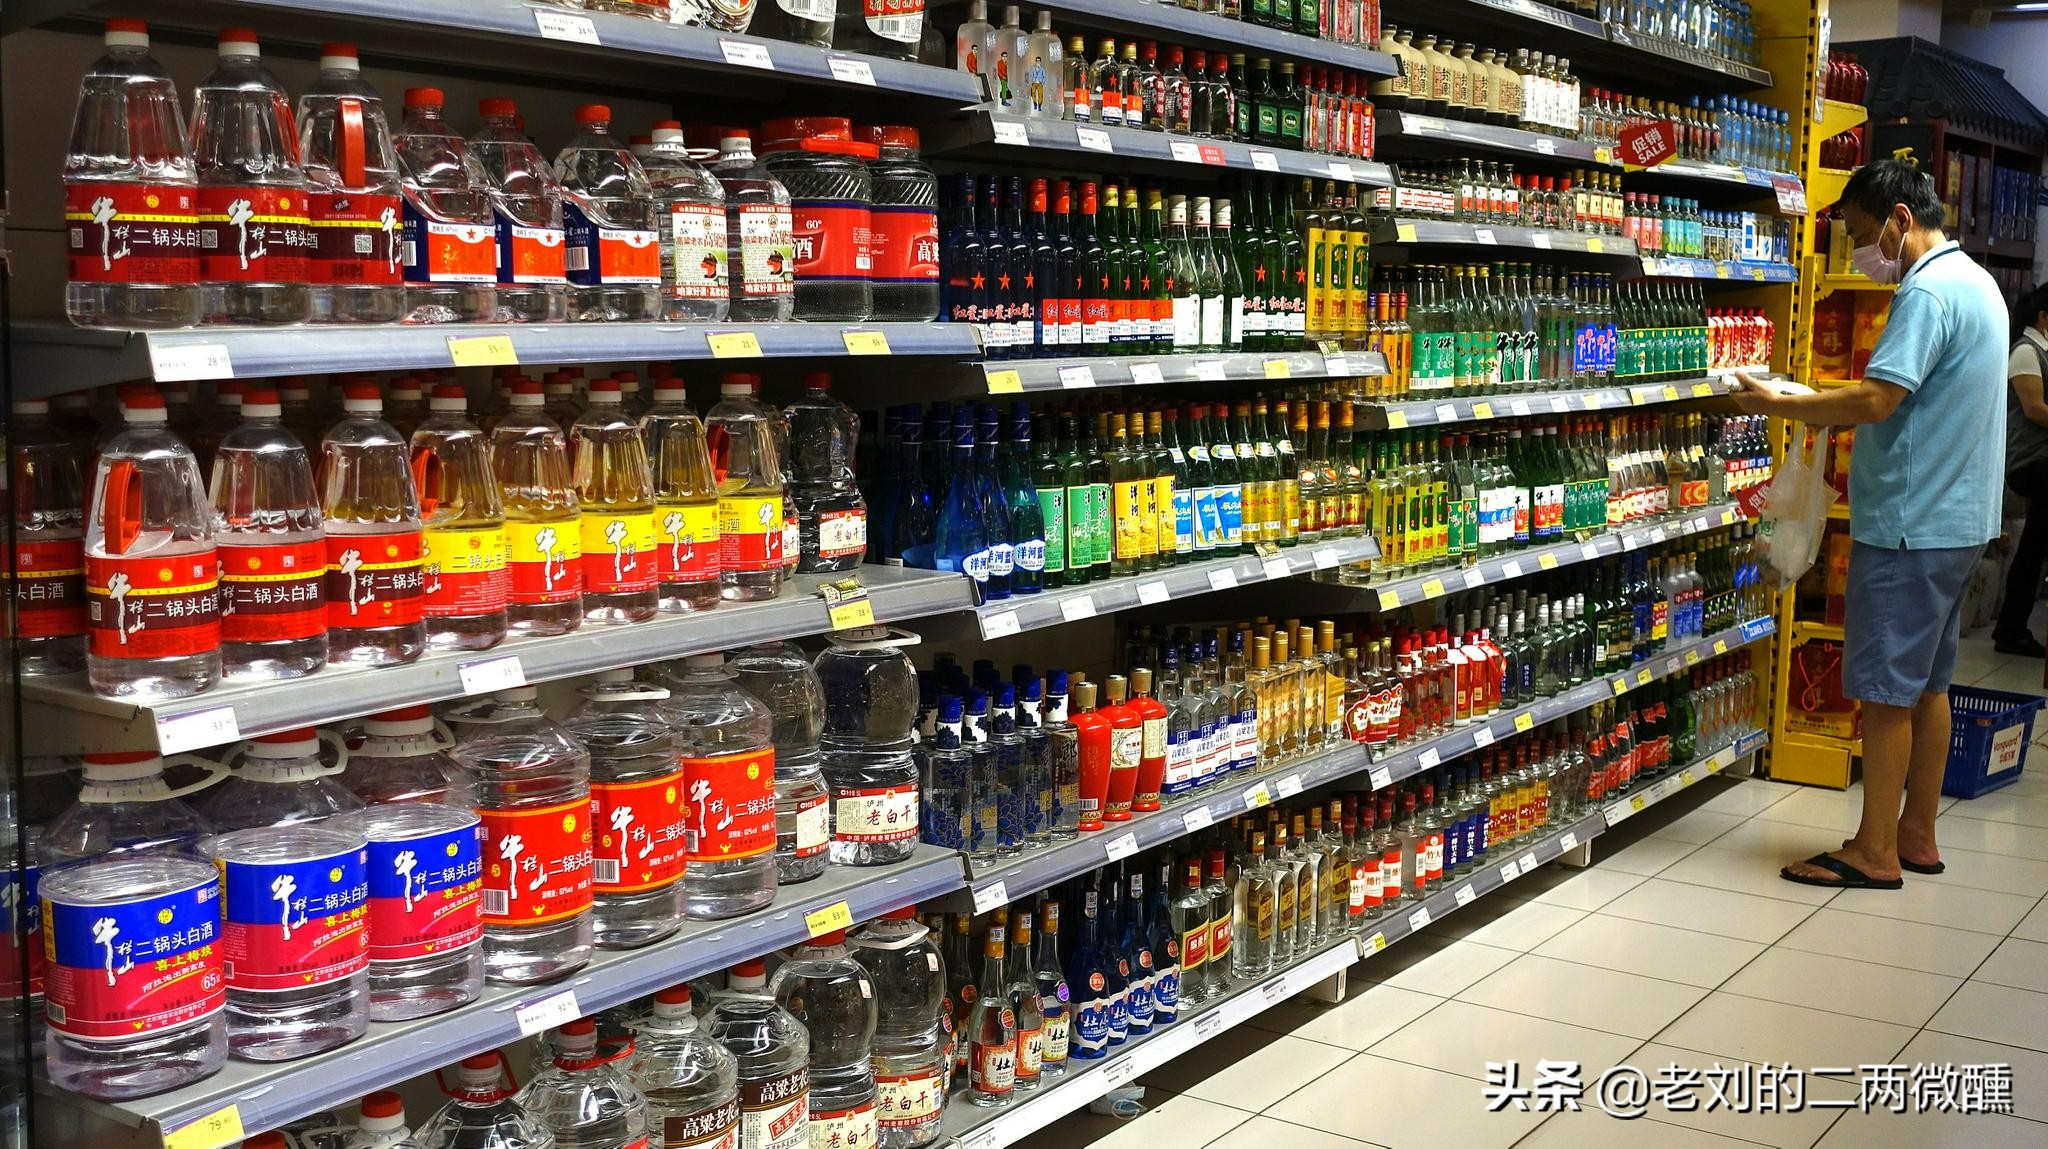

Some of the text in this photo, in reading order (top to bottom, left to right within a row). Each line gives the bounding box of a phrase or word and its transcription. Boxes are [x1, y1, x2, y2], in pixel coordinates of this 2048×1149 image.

[1631, 127, 1662, 154] 促销
[1638, 141, 1667, 163] SALE
[132, 226, 200, 247] 二锅头白
[806, 219, 823, 230] 60°
[236, 582, 318, 604] 二锅头白酒
[690, 779, 734, 839] 牛栏山
[866, 804, 911, 826] 老白干
[610, 805, 655, 868] 牛栏山
[500, 834, 548, 900] 牛栏山
[394, 850, 429, 913] 牛栏山
[271, 874, 309, 941] 牛栏山
[92, 916, 136, 987] 牛栏山
[135, 920, 214, 957] 二锅头白酒
[154, 945, 214, 972] 喜上梅烧
[879, 1090, 928, 1112] 老白干
[826, 1123, 872, 1149] 老白干
